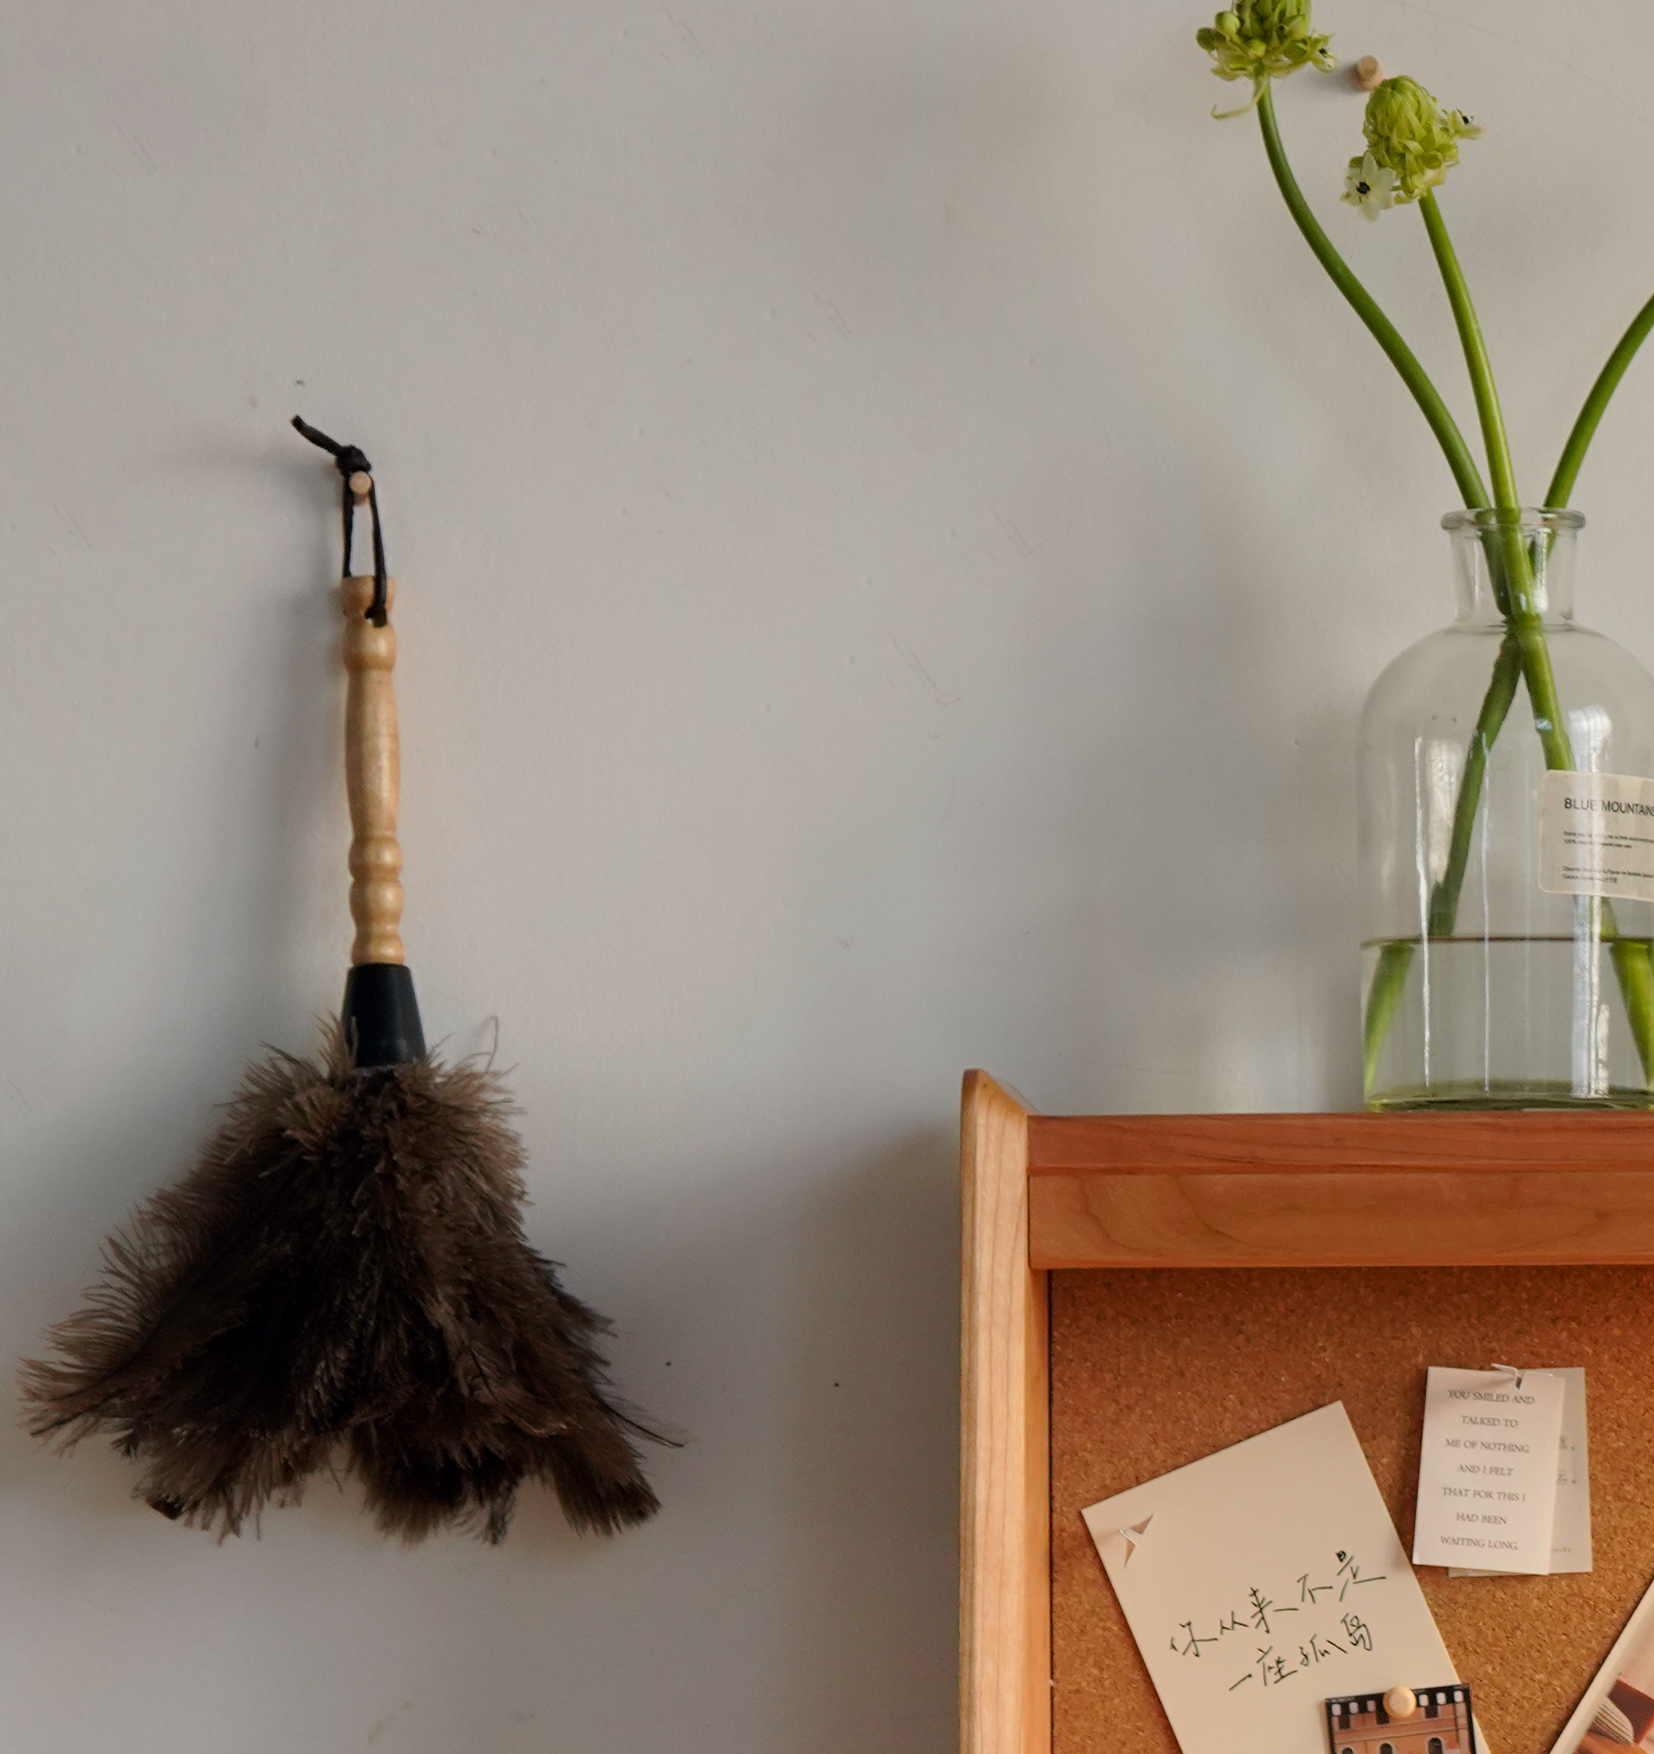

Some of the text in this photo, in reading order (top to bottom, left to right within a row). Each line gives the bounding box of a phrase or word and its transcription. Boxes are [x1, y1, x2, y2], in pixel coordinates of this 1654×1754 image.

[1564, 798, 1599, 810] BLUE
[1448, 1389, 1534, 1405] YOU SMILED AND
[1461, 1415, 1518, 1428] TALKED TO
[1446, 1438, 1529, 1453] ME OF NOTHING
[1457, 1464, 1479, 1475] AND
[1489, 1466, 1514, 1476] FELT
[1442, 1487, 1470, 1497] THAT
[1473, 1489, 1492, 1499] FOR
[1496, 1491, 1520, 1501] THIS
[1456, 1513, 1507, 1525] HAD BEEN
[1440, 1535, 1485, 1548] WAITING
[1169, 1549, 1387, 1658] 你从来不是
[1229, 1612, 1373, 1692] 一座孤岛
